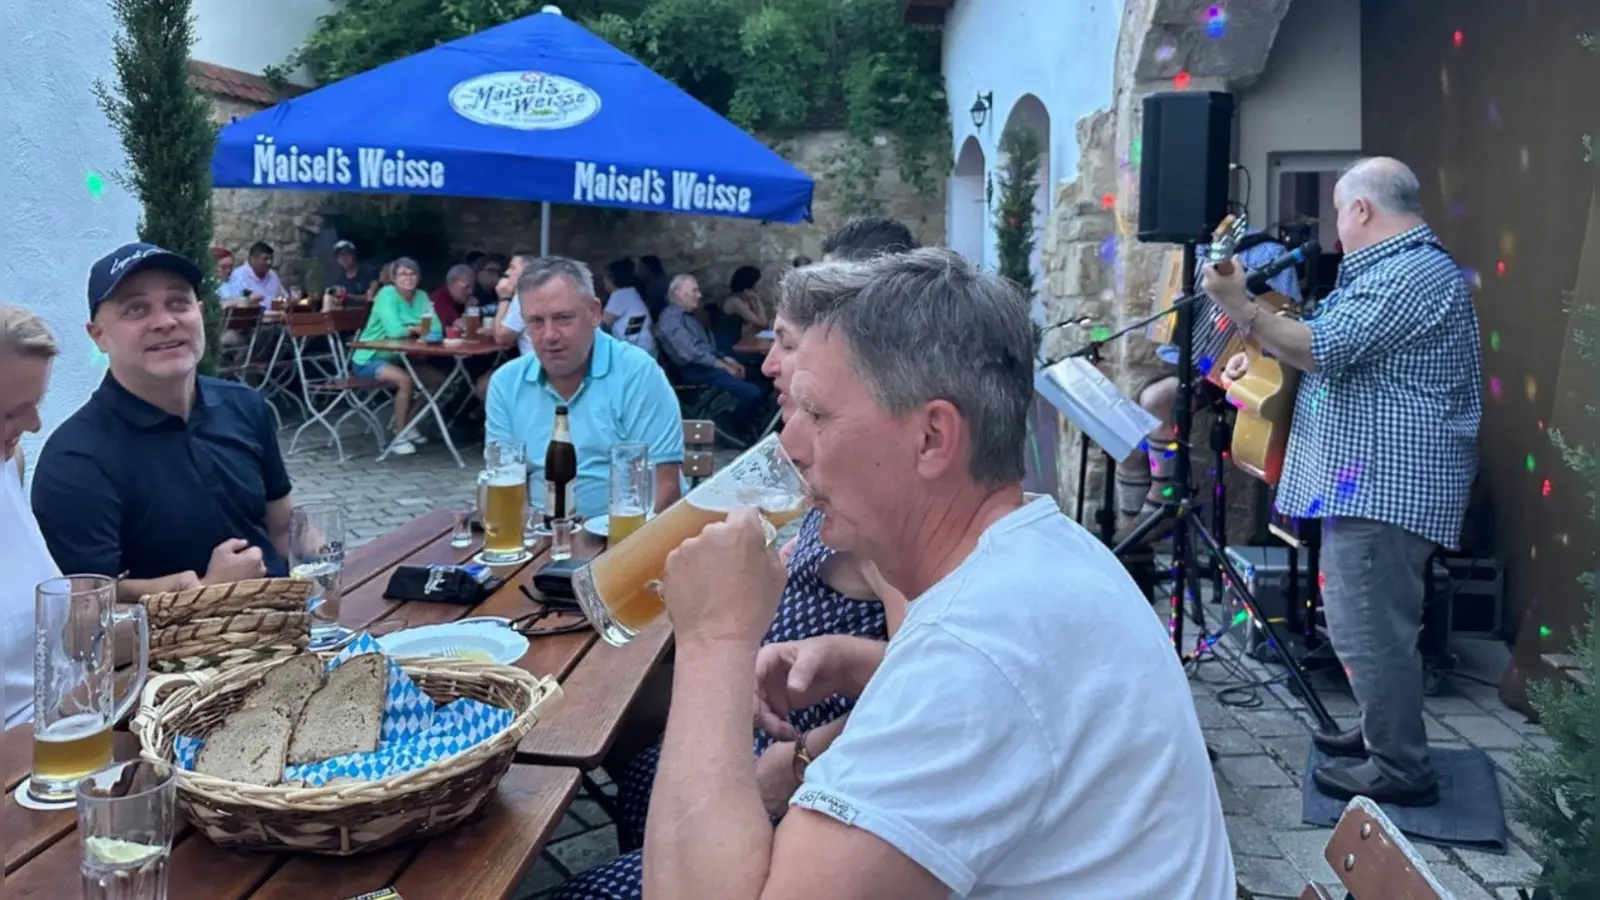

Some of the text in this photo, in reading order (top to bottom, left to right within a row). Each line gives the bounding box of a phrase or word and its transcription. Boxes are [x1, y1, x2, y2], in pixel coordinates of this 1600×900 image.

[513, 92, 586, 114] Weisse
[253, 134, 446, 188] Maisel's Weisse
[573, 161, 752, 213] Maisel's Weisse
